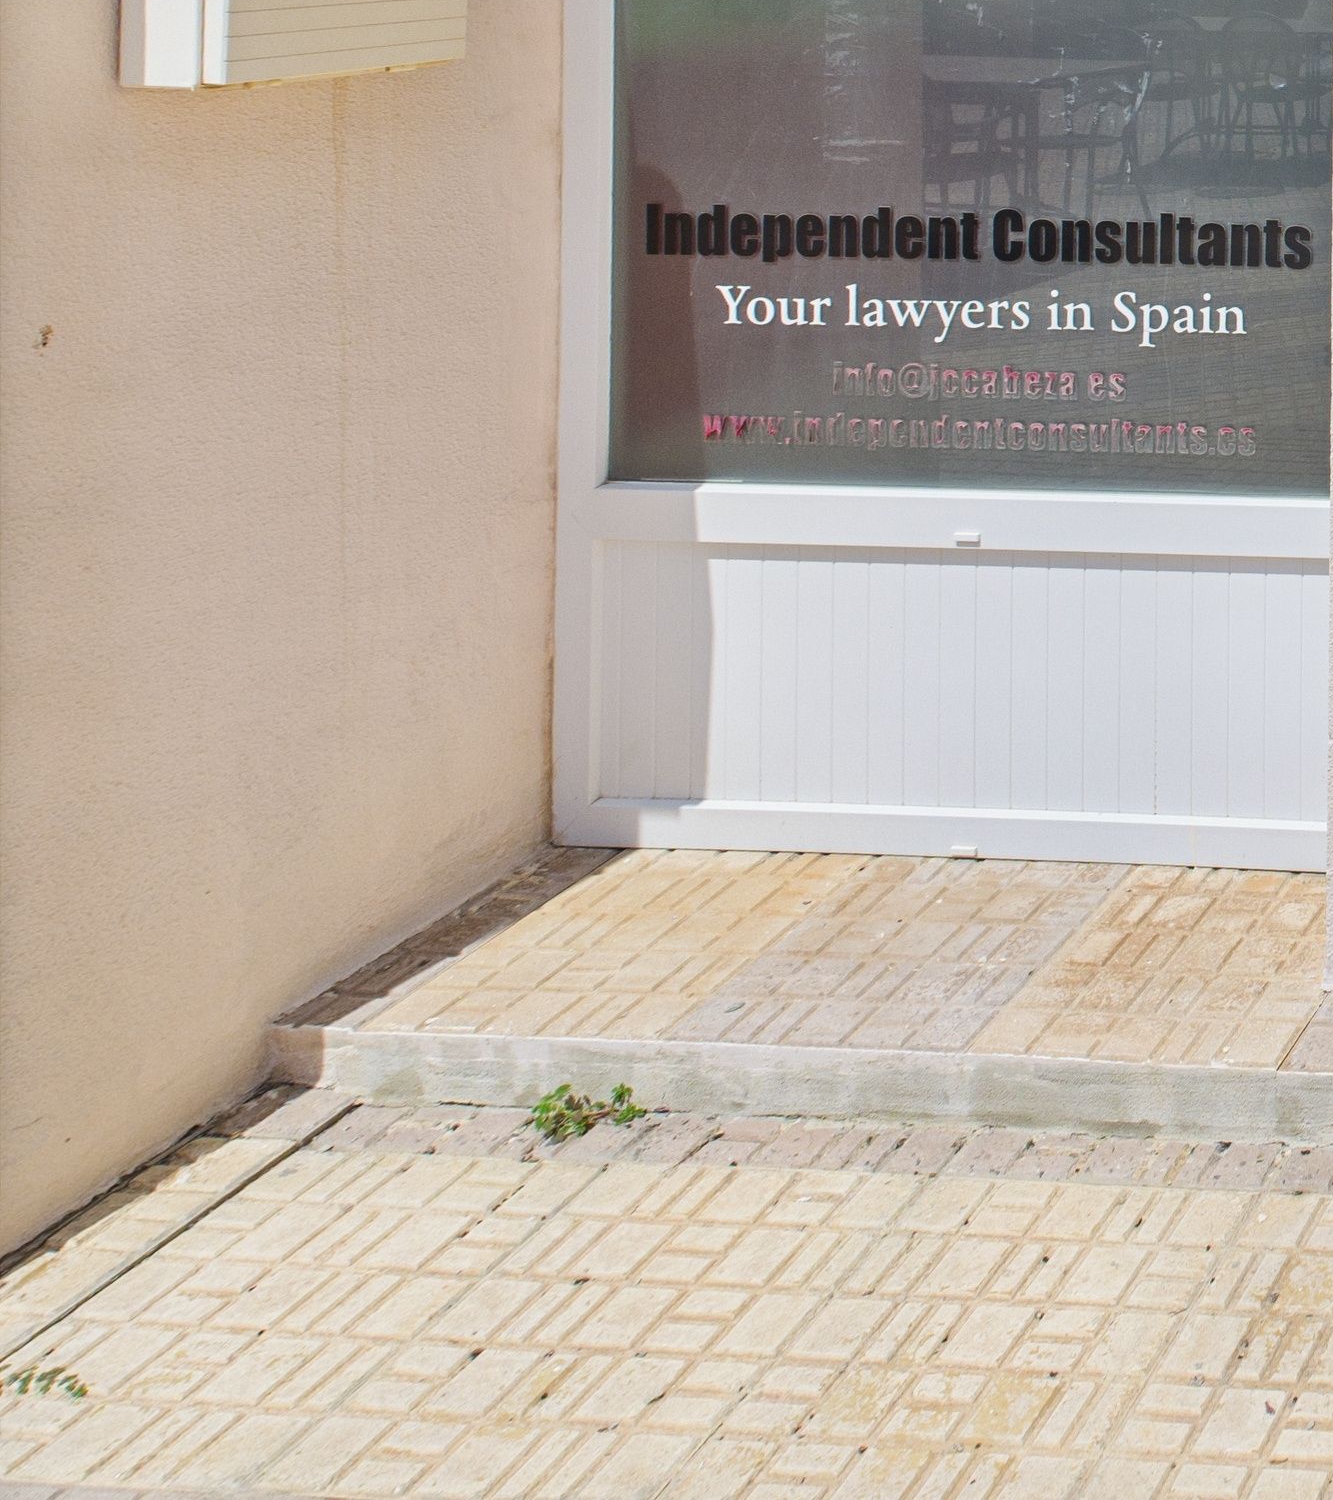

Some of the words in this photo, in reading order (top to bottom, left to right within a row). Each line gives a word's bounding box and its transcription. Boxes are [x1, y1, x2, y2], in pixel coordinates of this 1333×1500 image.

[644, 201, 980, 263] Independent
[992, 206, 1314, 271] Consultants
[715, 284, 831, 327] Your
[845, 283, 1031, 343] lawyers
[1046, 289, 1095, 333] in
[1111, 289, 1248, 348] Spain
